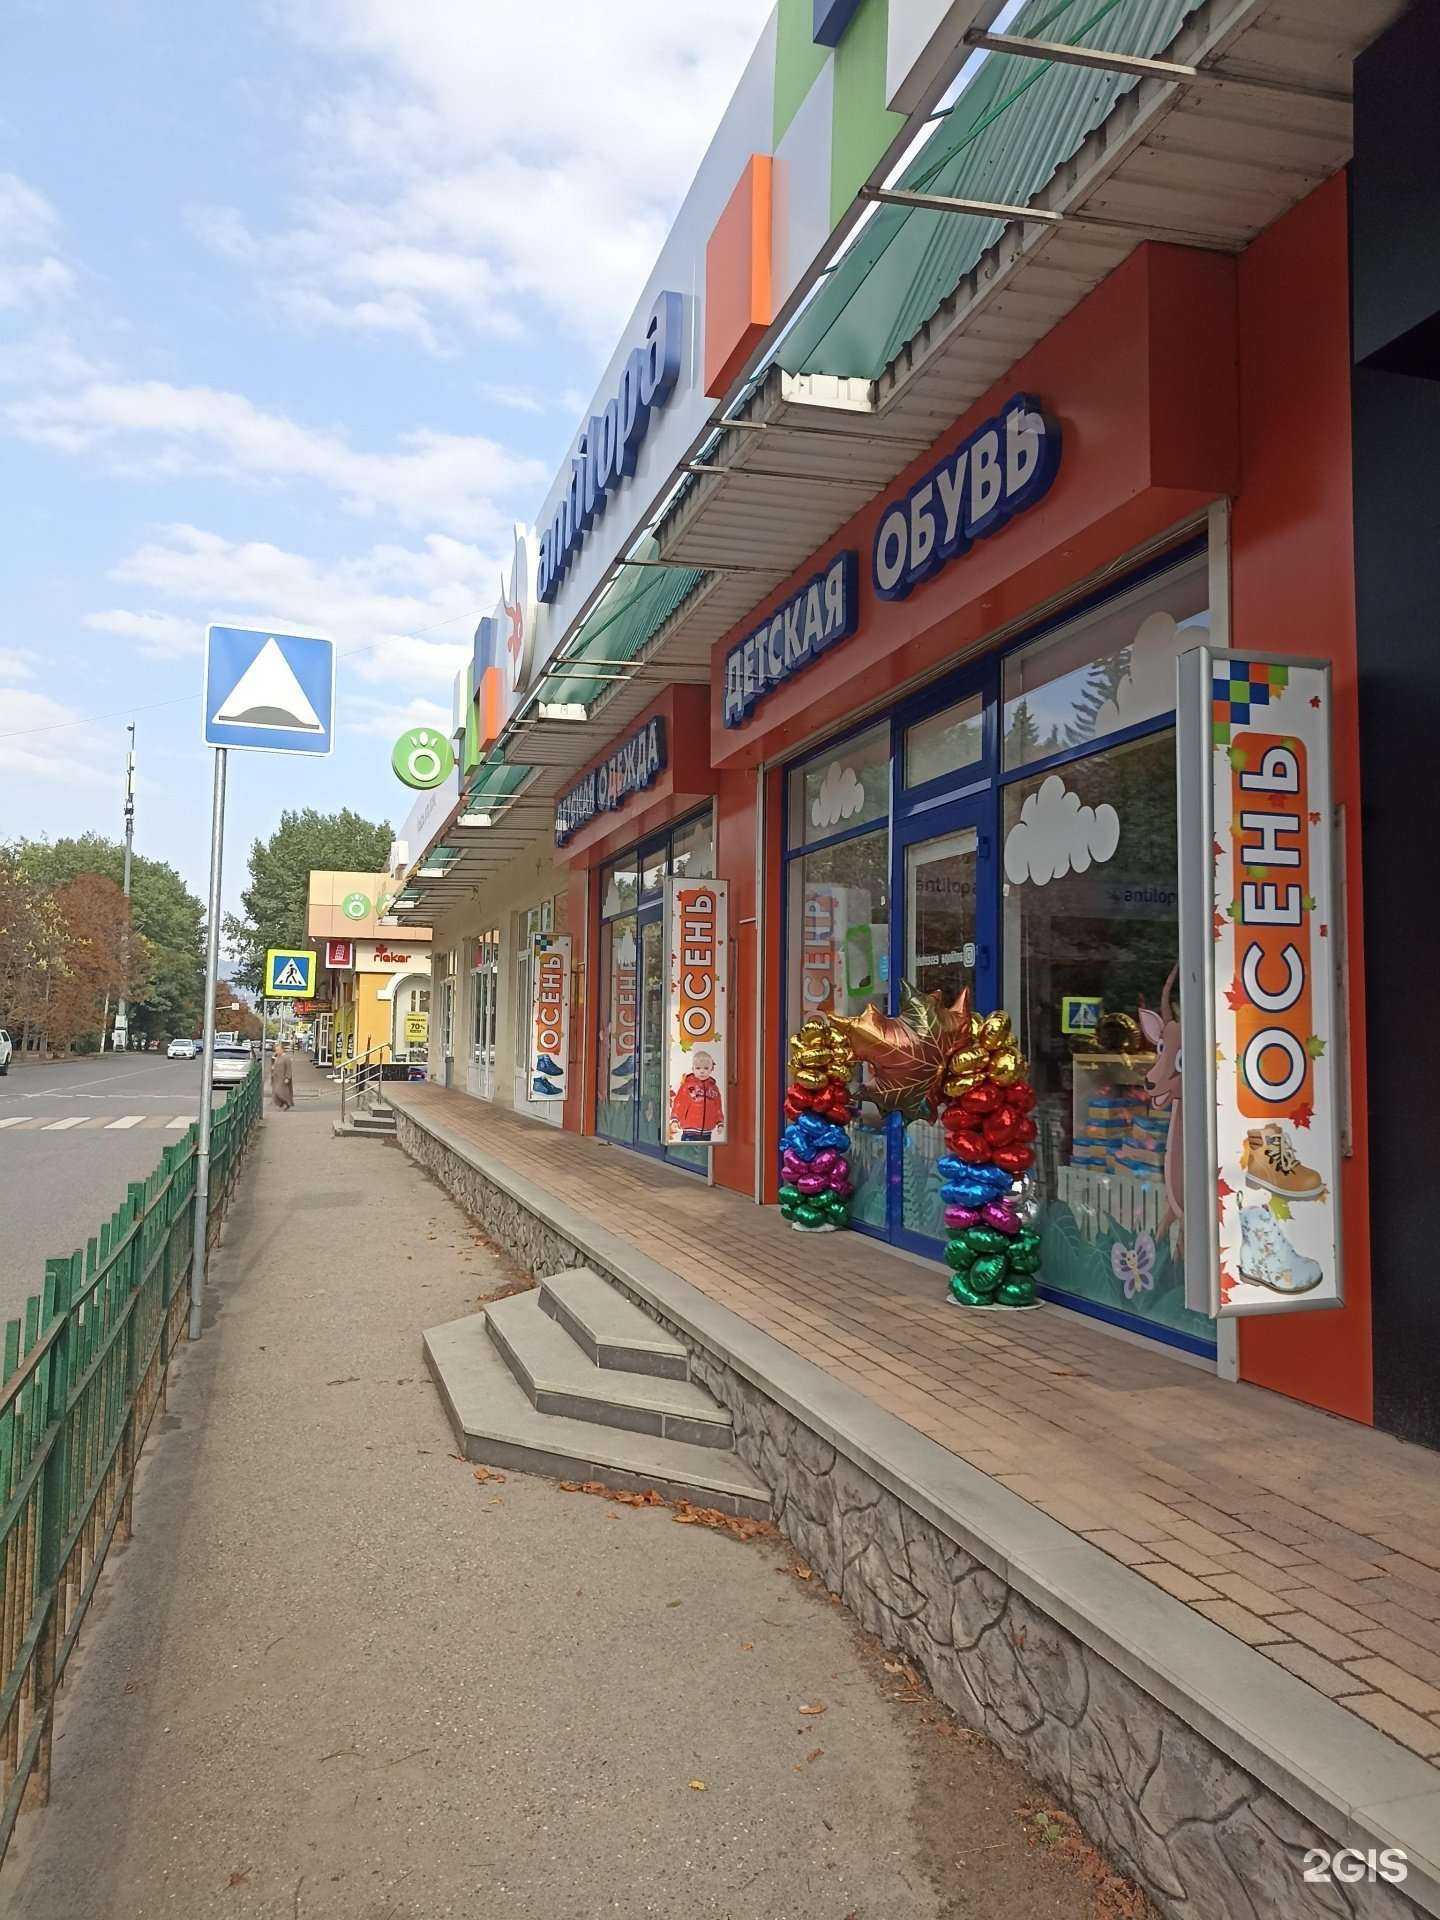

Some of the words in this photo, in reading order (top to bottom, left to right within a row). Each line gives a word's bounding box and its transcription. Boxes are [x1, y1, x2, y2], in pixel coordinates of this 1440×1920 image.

[536, 290, 683, 603] antilopa
[725, 559, 844, 721] ДЕТСКАЯ
[875, 407, 1046, 591] ОБУВЬ
[598, 719, 658, 806] ОДЕЖДА
[539, 954, 562, 1049] ОСЕНЬ
[682, 894, 714, 1036] ОСЕНЬ
[1240, 746, 1306, 1103] ОСЕНЬ
